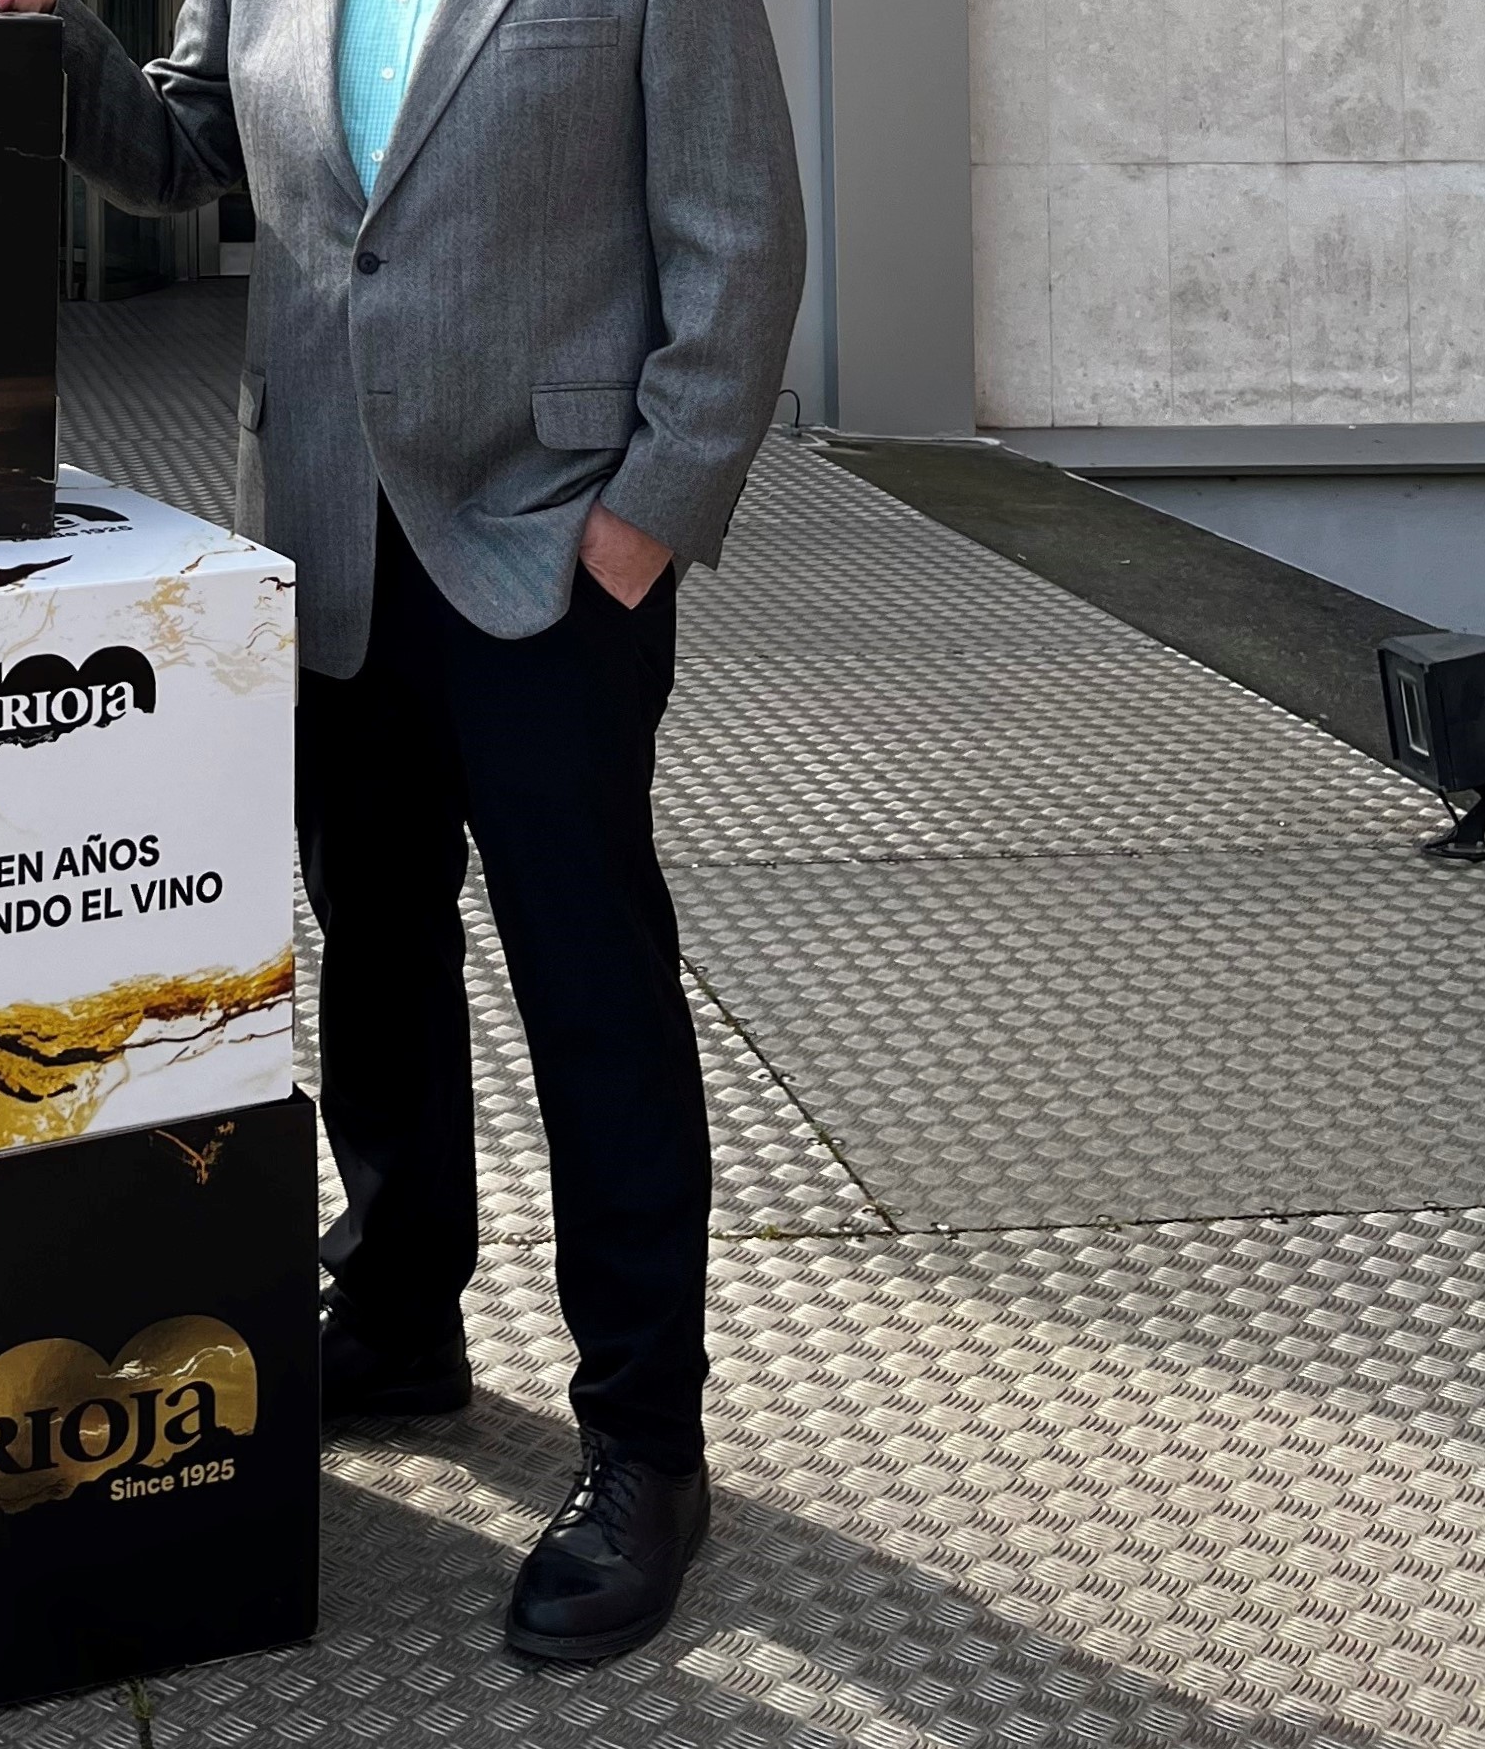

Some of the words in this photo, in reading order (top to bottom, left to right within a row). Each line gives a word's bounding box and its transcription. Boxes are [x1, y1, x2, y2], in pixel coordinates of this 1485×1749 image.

[53, 834, 160, 881] AÑOS
[81, 887, 123, 923] EL
[131, 872, 224, 914] VINO
[110, 1473, 175, 1502] Since
[180, 1458, 236, 1490] 1925
